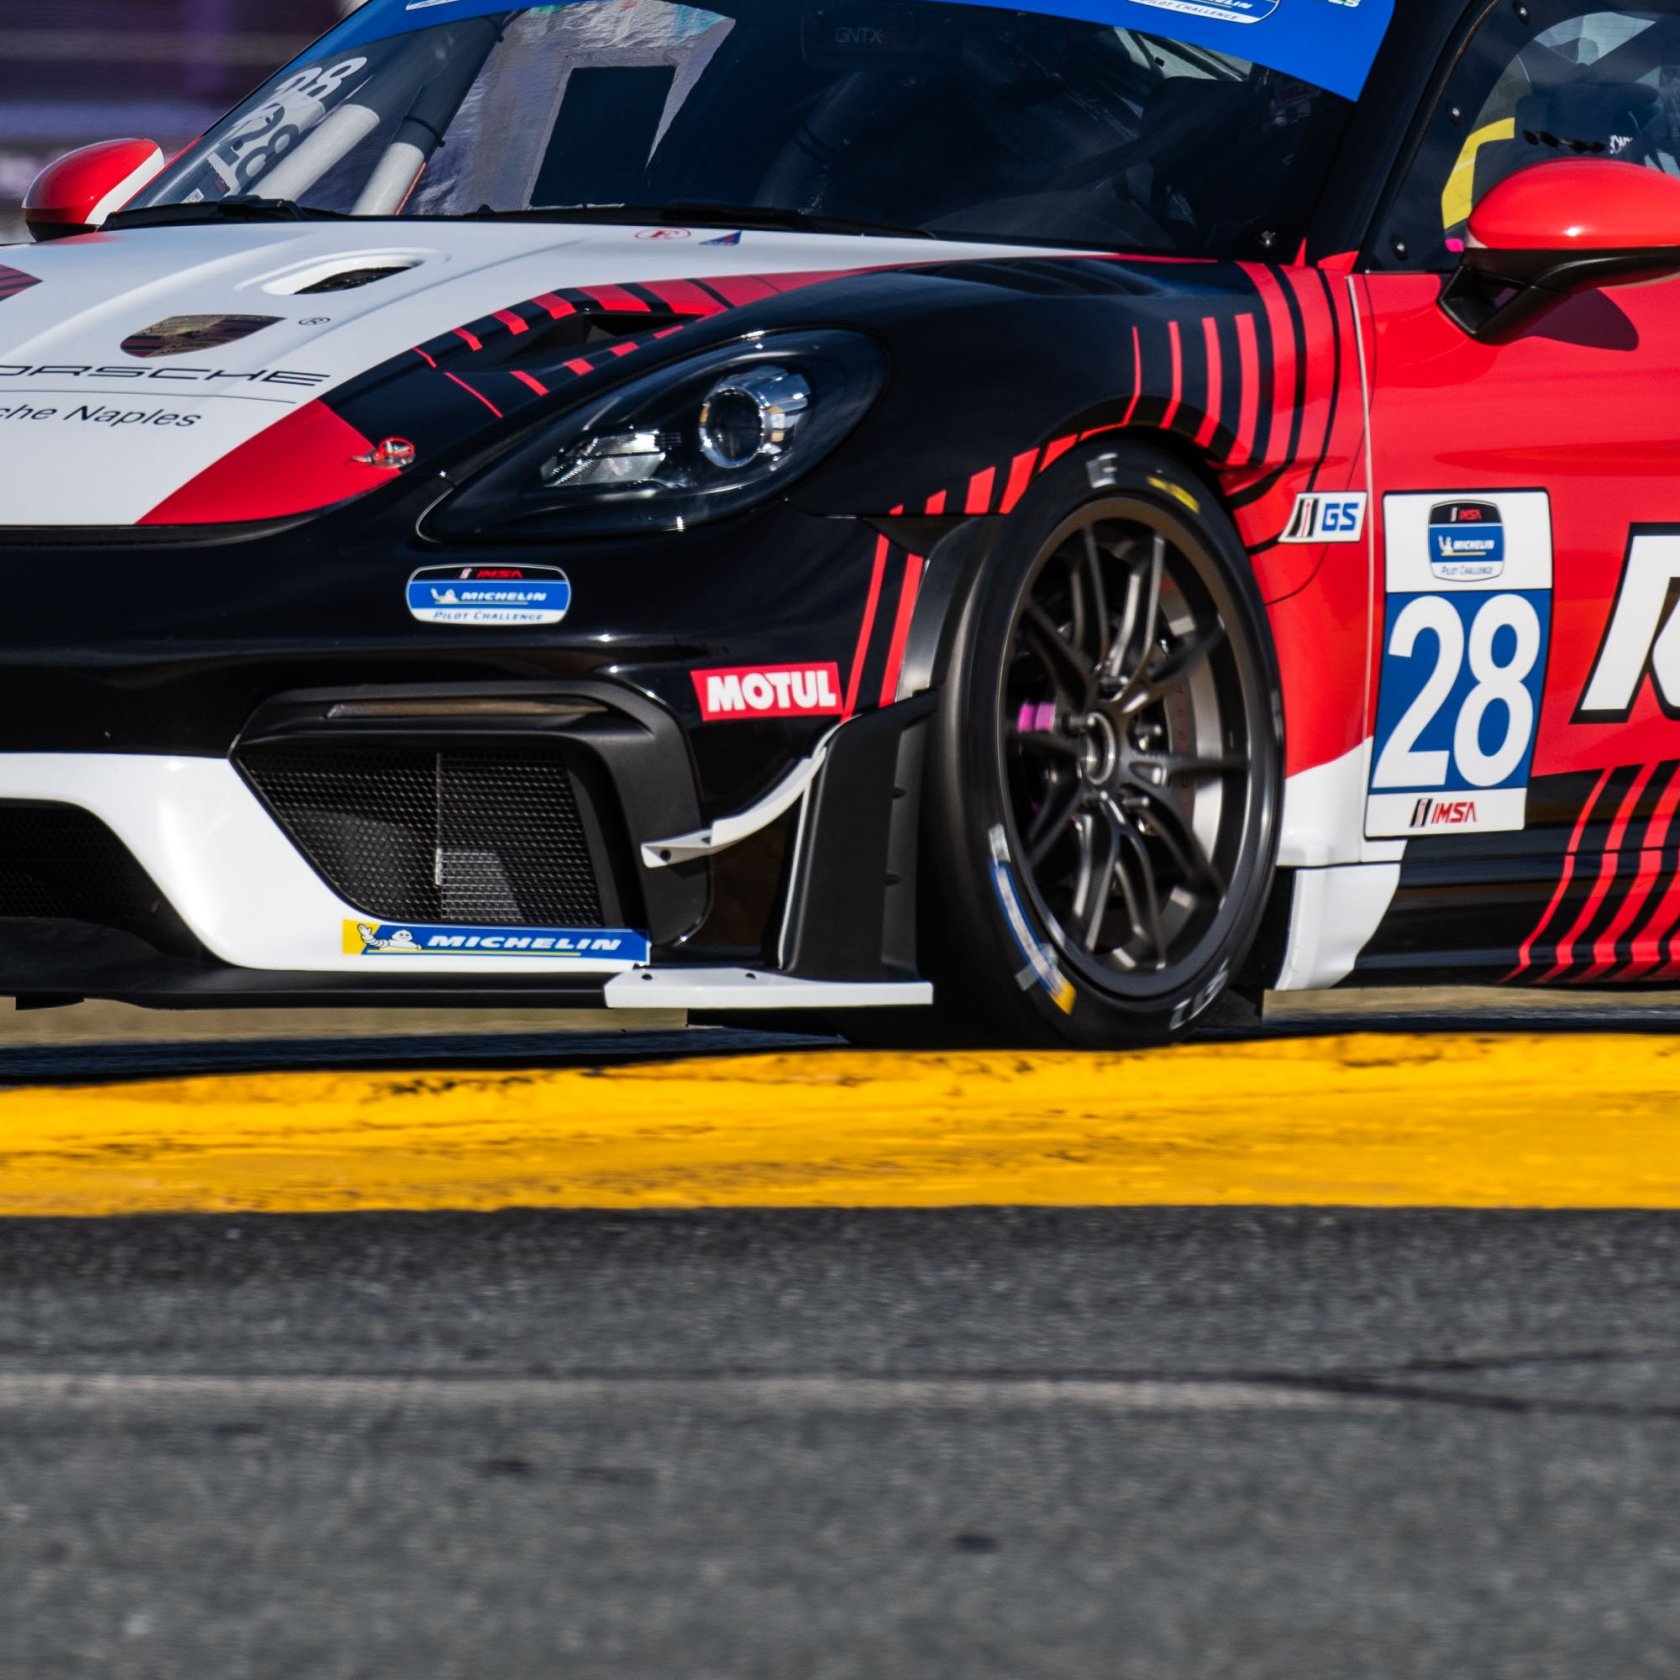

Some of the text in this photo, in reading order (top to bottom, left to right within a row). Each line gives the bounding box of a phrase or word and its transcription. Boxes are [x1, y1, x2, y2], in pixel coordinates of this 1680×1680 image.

[64, 405, 202, 427] Naples
[1321, 502, 1360, 532] GS
[476, 569, 523, 579] IMSA
[461, 591, 547, 601] MICHELIN
[434, 610, 543, 621] PILOT CHALLENGE
[707, 670, 836, 712] MOTUL
[1371, 593, 1541, 787] 28
[1431, 801, 1477, 824] IMSA
[427, 935, 622, 951] MICHELIN
